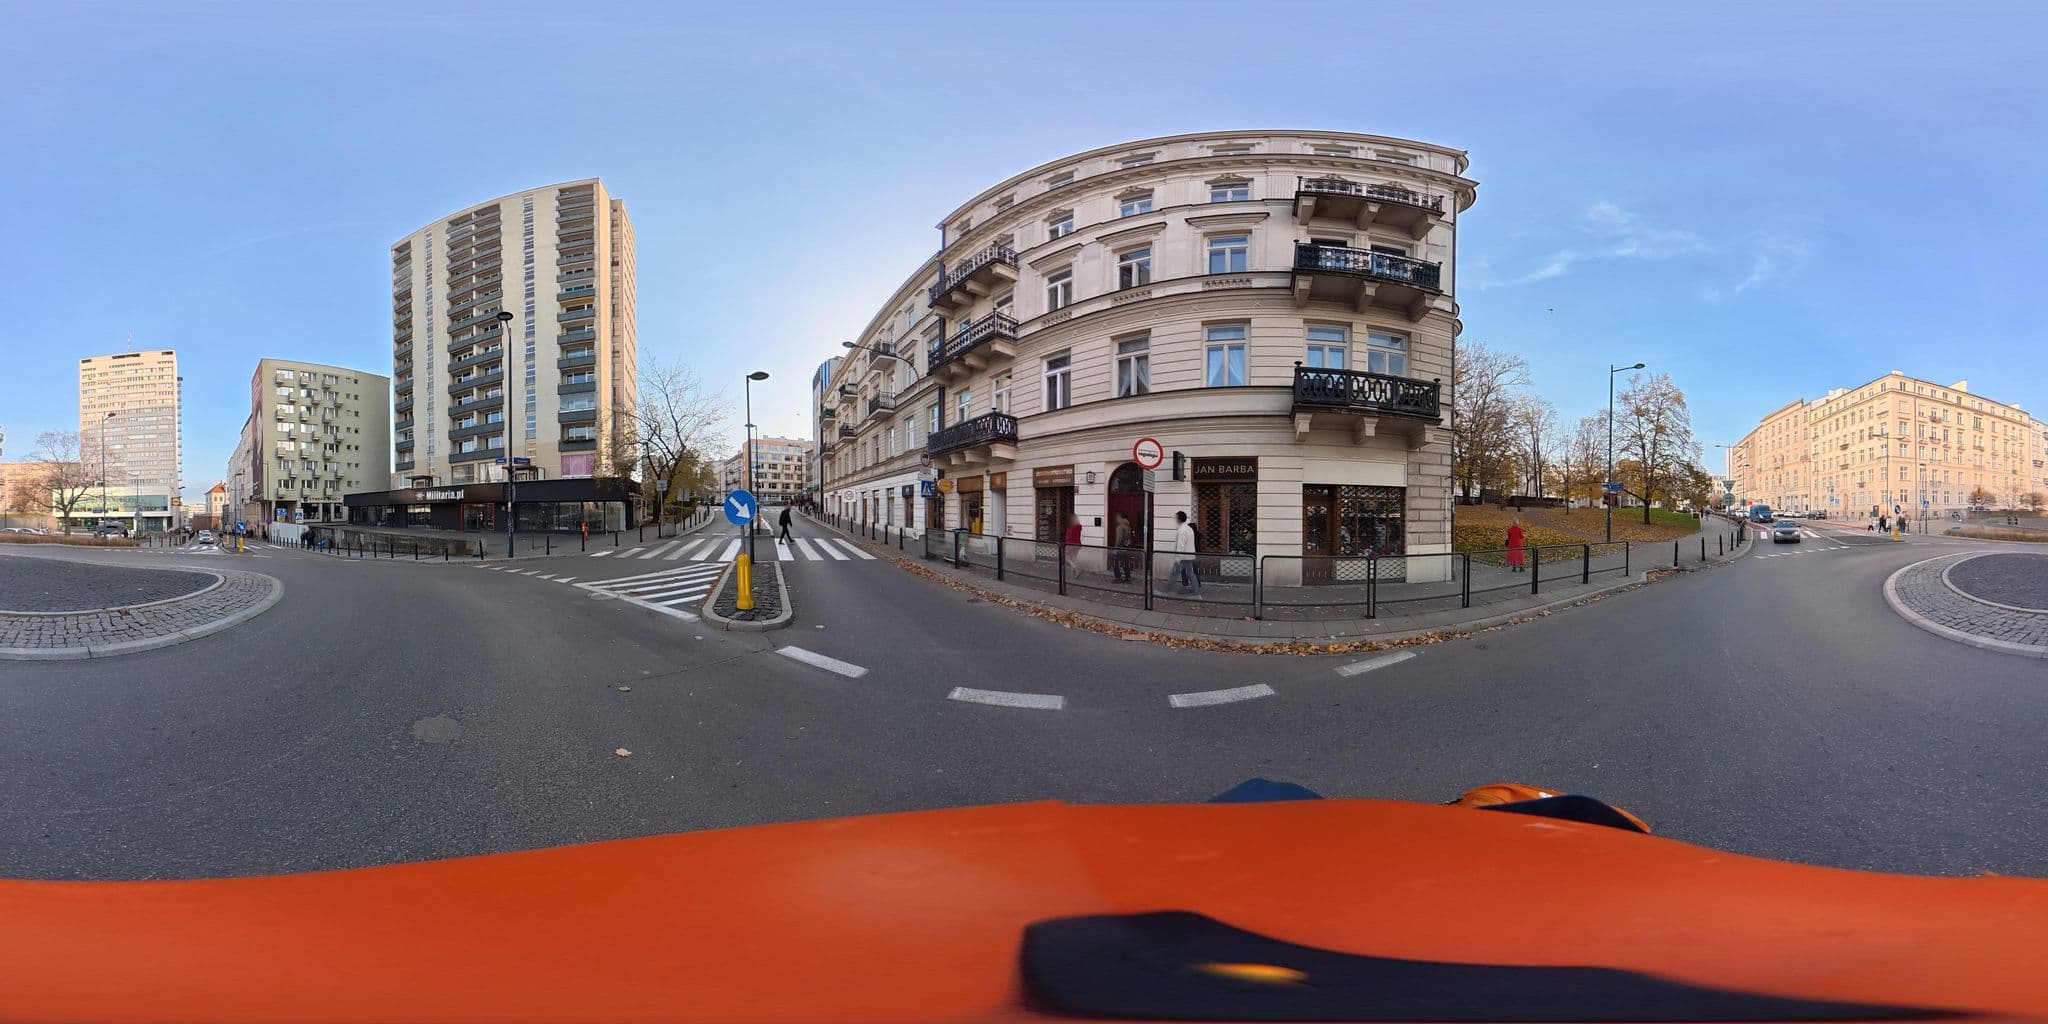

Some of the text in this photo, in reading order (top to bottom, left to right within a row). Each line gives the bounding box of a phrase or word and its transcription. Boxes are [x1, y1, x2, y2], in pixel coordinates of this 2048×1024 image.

[1195, 465, 1254, 474] JAN BARBA
[426, 489, 464, 500] Militaria.pl
